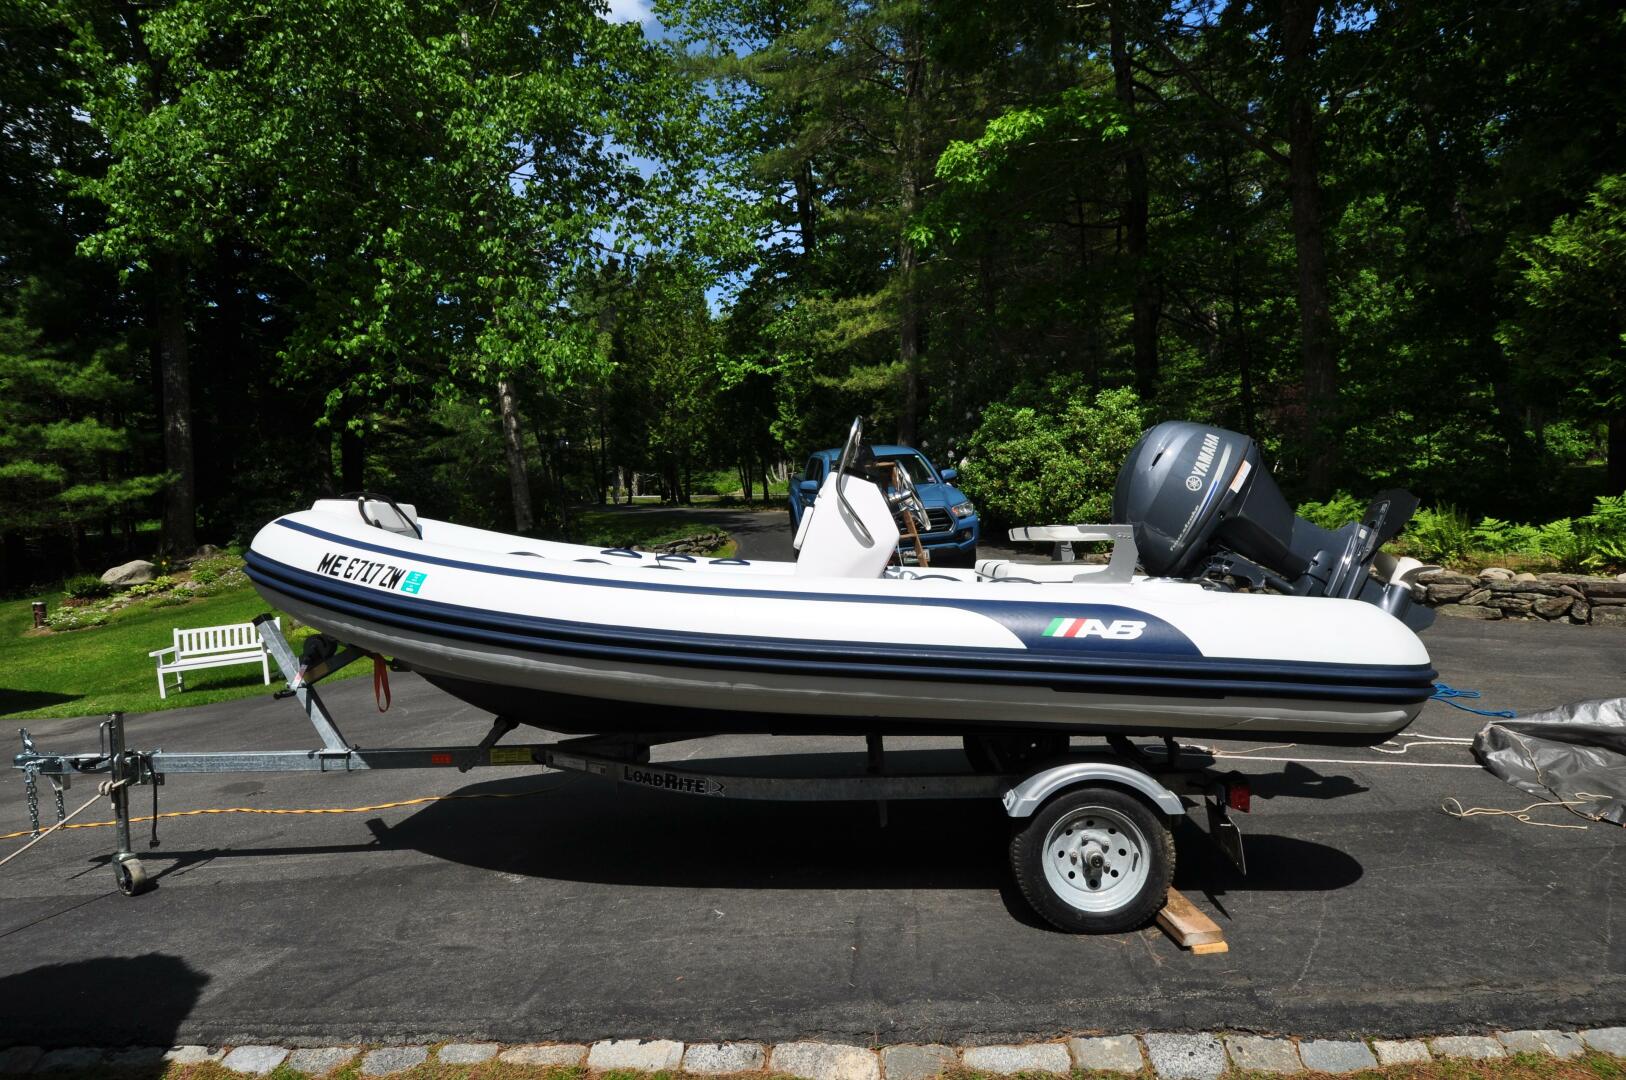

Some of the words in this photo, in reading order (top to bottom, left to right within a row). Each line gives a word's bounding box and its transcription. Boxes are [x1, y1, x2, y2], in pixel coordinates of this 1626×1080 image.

[1191, 433, 1220, 477] YAMAHA
[317, 553, 348, 576] ME
[379, 565, 406, 589] ZW
[1074, 618, 1147, 640] AB
